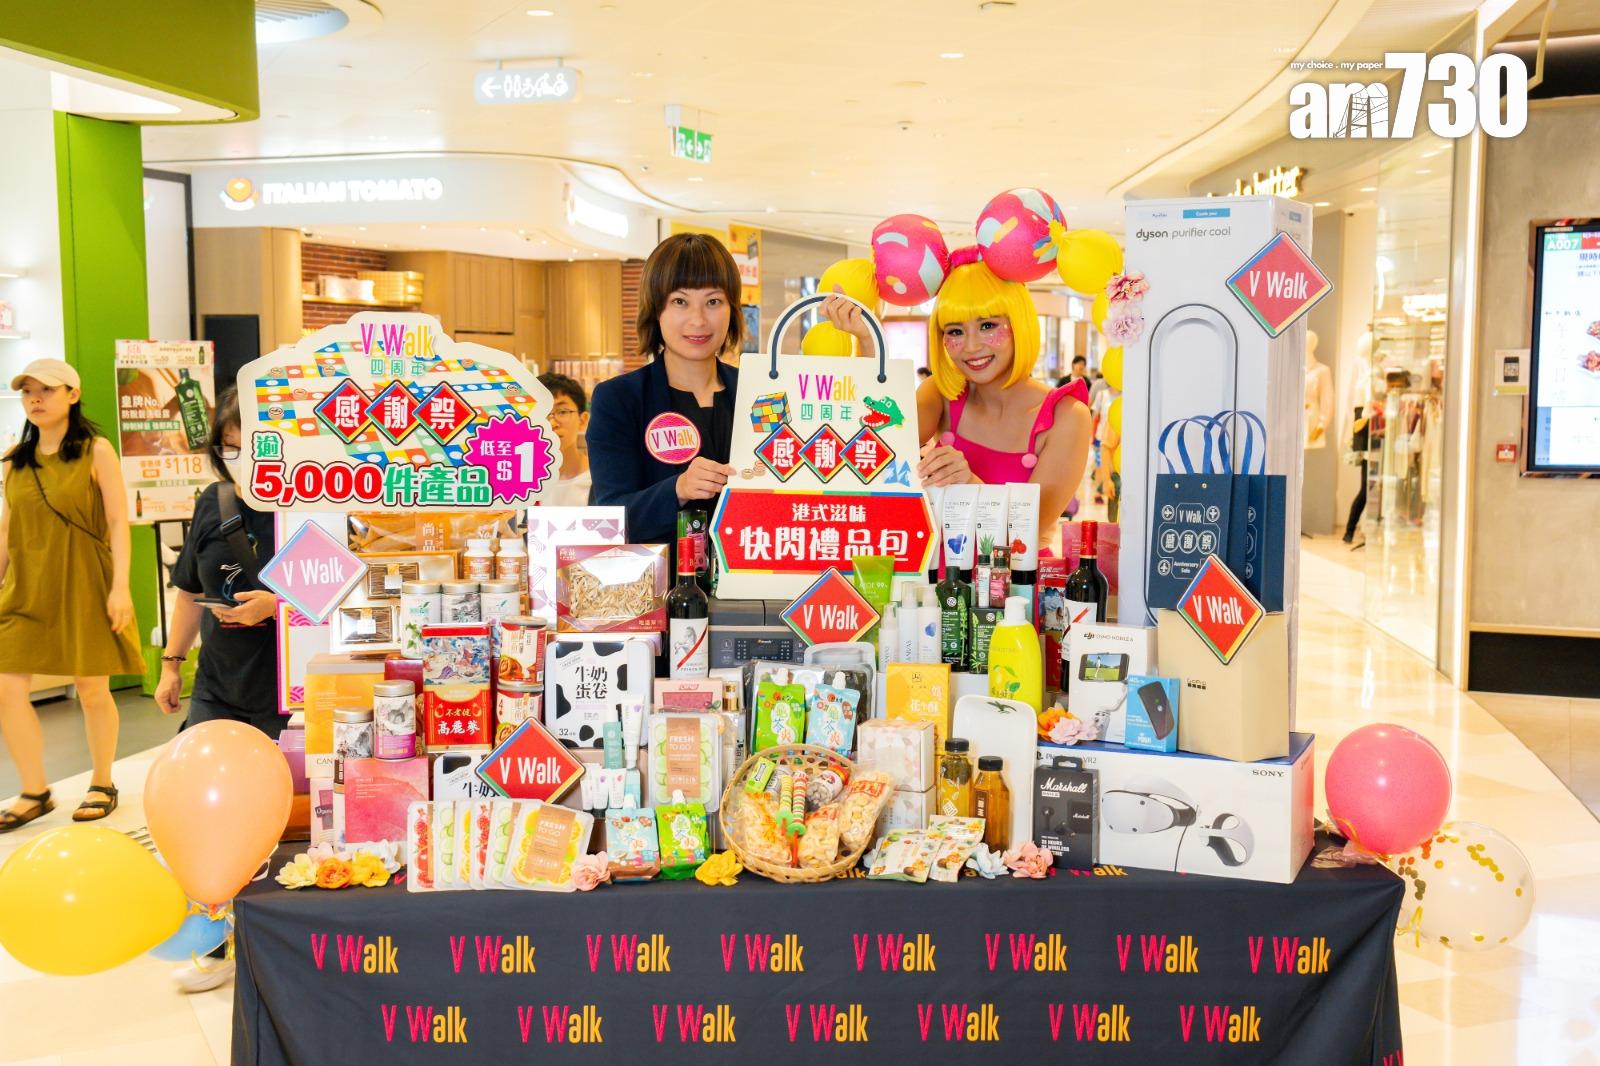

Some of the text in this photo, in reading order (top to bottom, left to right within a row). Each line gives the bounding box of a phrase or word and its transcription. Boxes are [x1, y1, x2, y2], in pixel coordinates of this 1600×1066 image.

[262, 177, 443, 206] ITALIAN TOMATO
[1136, 226, 1231, 241] dyson purifier cool
[1546, 240, 1580, 250] A007
[1579, 252, 1600, 261] 現時
[1250, 271, 1308, 299] V Walk
[360, 323, 437, 358] V Walk
[370, 359, 426, 377] 四周年
[798, 373, 857, 402] V Walk
[334, 395, 457, 429] 感謝祭
[800, 403, 853, 422] 四周年
[255, 434, 282, 458] 逾
[480, 440, 512, 457] 低至
[651, 429, 695, 450] V Walk
[772, 437, 878, 470] 感謝祭
[165, 456, 203, 475] $118
[496, 441, 535, 484] $1
[791, 503, 868, 523] 港式滋味
[1179, 510, 1202, 523] V Walk
[739, 526, 909, 562] 快閃禮品包
[282, 557, 345, 587] V Walk
[803, 605, 859, 630] V Walk
[1192, 595, 1245, 625] V Walk
[575, 665, 608, 682] 牛奶
[575, 683, 608, 699] 蛋卷
[559, 728, 569, 736] 32
[500, 757, 561, 785] V Walk
[1040, 777, 1088, 793] Marshall
[1252, 769, 1284, 778] SONY
[836, 868, 866, 878] alk
[311, 933, 398, 973] V Walk
[450, 936, 535, 973] V Walk
[586, 934, 670, 972] V Walk
[721, 934, 804, 972] V Walk
[853, 934, 935, 971] V Walk
[985, 933, 1067, 971] V Walk
[1117, 935, 1198, 973] V Walk
[1249, 937, 1330, 974] V Walk
[381, 1004, 467, 1043] V Walk
[518, 1005, 602, 1043] V Walk
[653, 1004, 735, 1042] V Walk
[786, 1004, 868, 1042] V Walk
[918, 1004, 999, 1041] V Walk
[1049, 1004, 1130, 1041] V Walk
[1180, 1005, 1260, 1042] V Walk
